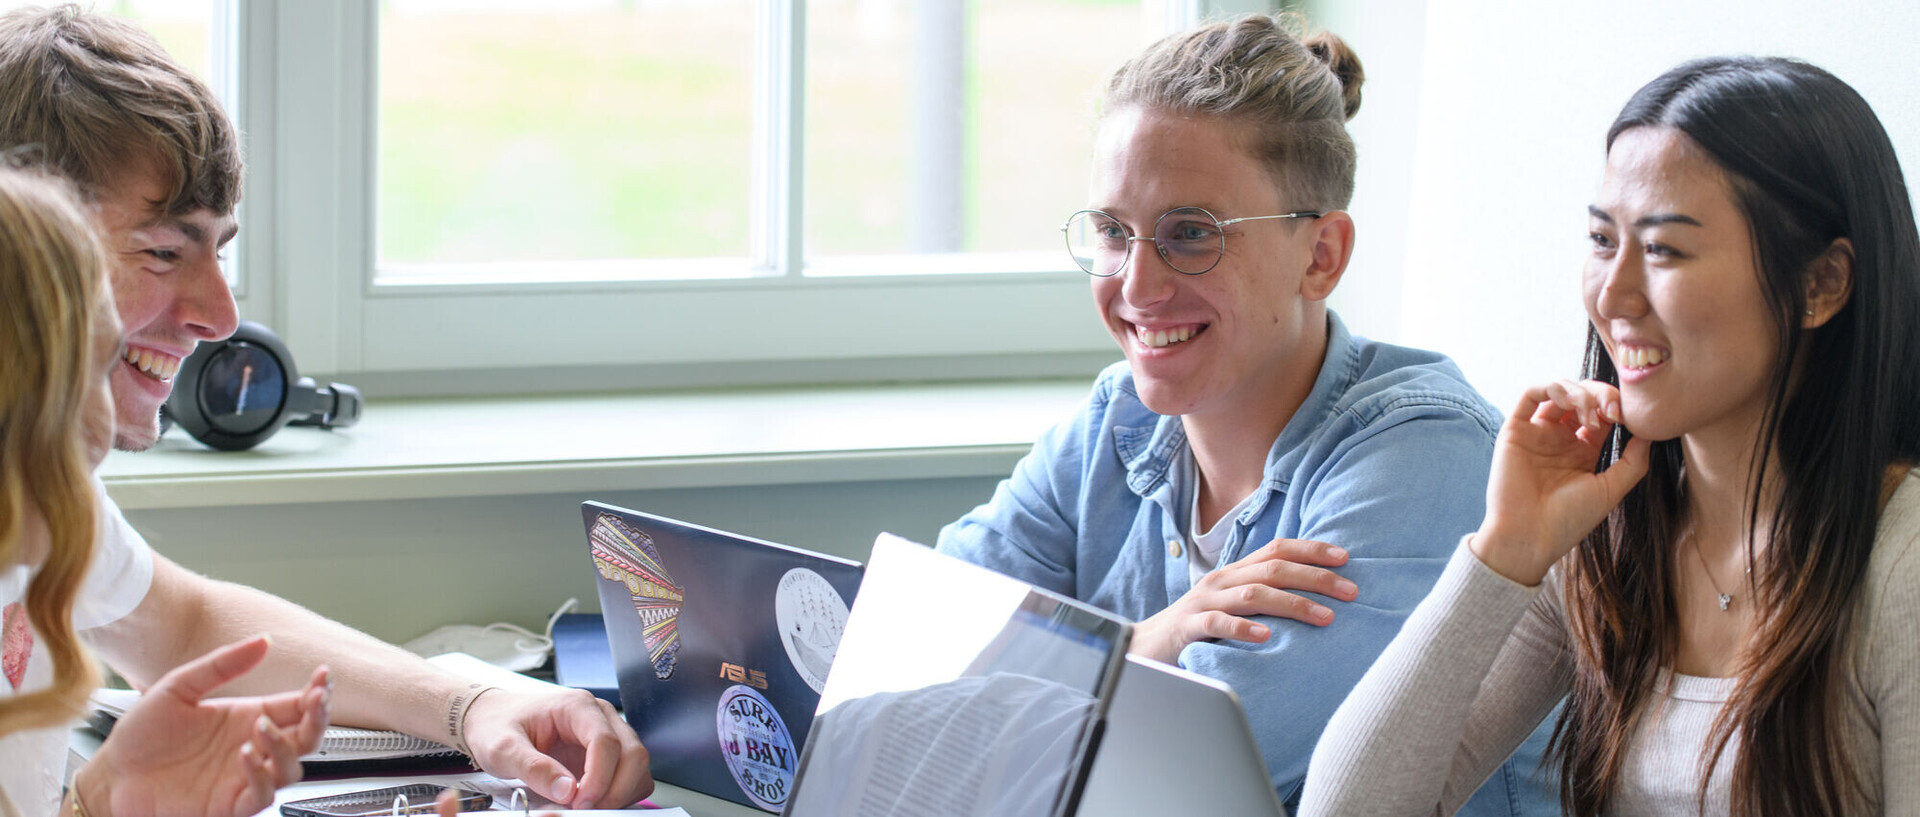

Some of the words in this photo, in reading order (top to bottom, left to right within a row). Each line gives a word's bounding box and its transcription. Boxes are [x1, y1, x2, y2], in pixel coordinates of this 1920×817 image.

[719, 661, 769, 690] ASUS
[729, 699, 777, 732] SURF
[729, 732, 740, 756] J
[743, 736, 788, 771] BAY
[742, 768, 786, 800] SHOP
